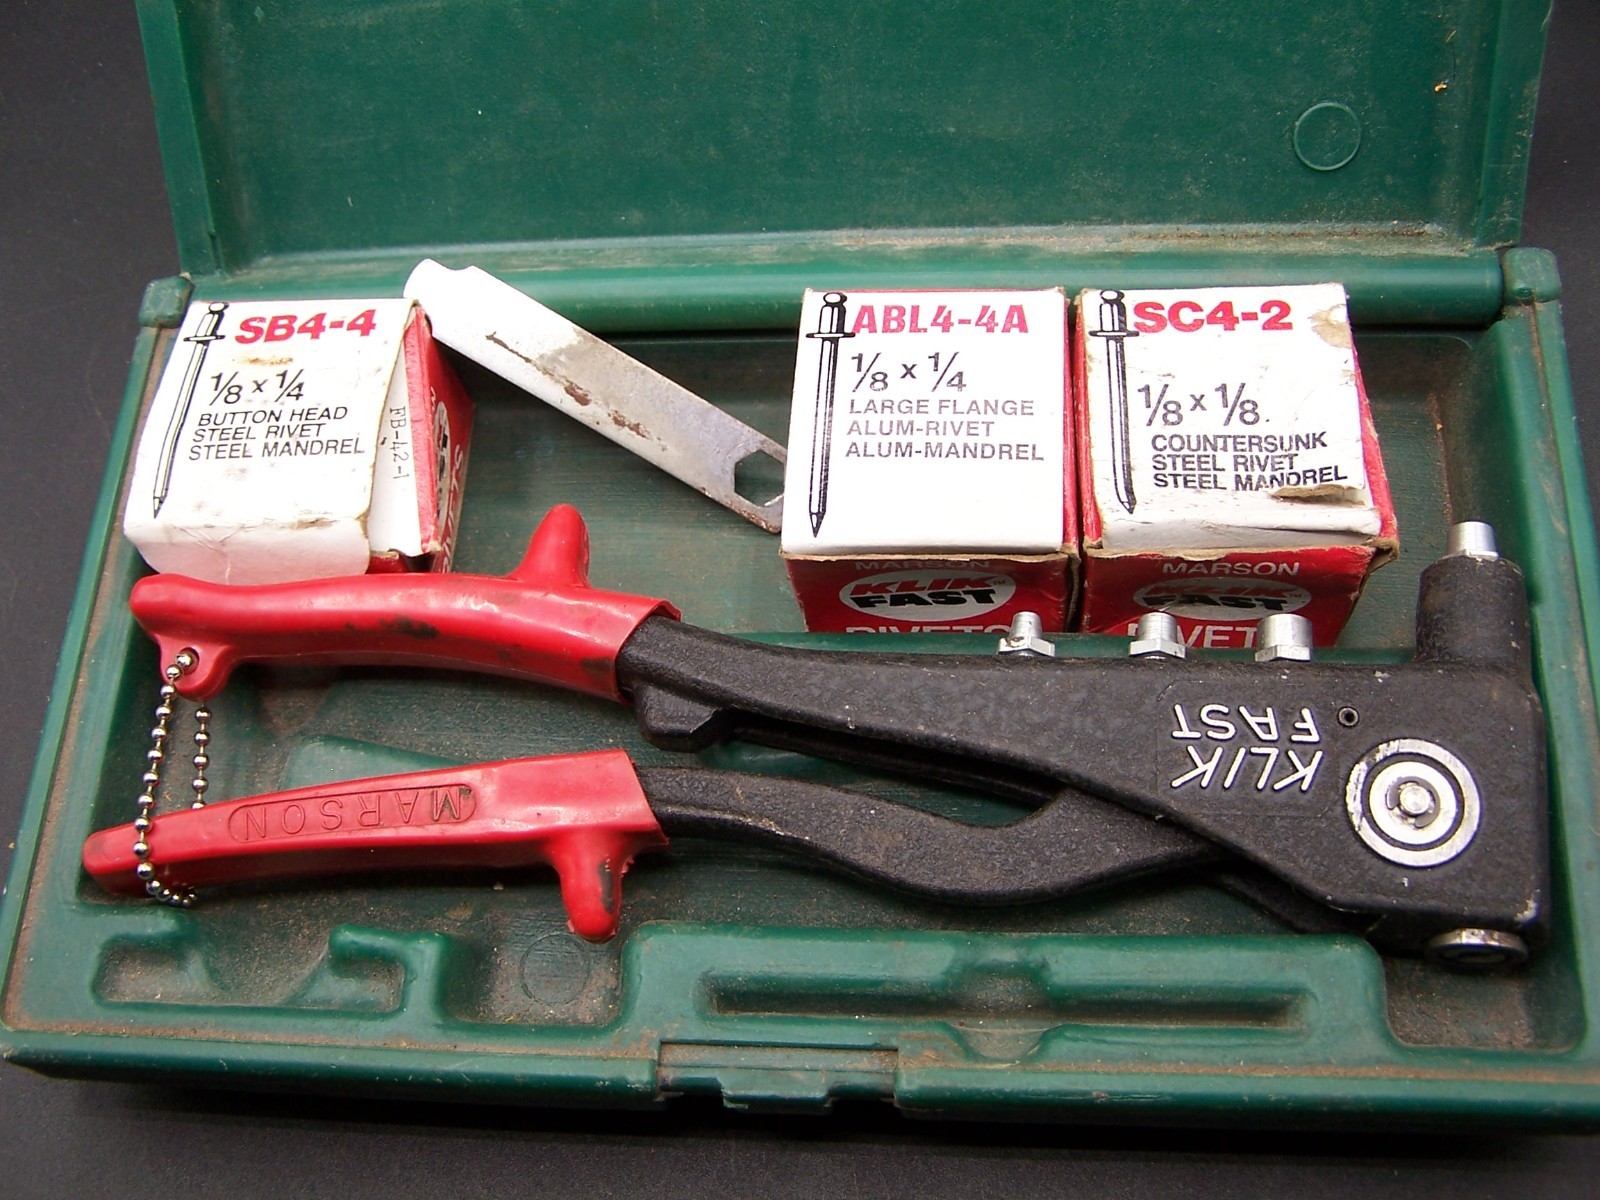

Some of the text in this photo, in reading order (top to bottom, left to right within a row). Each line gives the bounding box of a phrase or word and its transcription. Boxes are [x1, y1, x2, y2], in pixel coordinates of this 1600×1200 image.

[234, 309, 377, 345] SB4-4
[851, 304, 1030, 334] ABL4-4A
[1133, 299, 1294, 334] SC4-2
[851, 351, 967, 393] 1/8 x 1/4
[210, 369, 306, 406] 1/8 x 1/4
[197, 405, 349, 427] BUTTON HEAD
[849, 398, 1035, 417] LARGE FLANGE
[1136, 383, 1184, 427] 1/8
[1189, 393, 1208, 412] x
[192, 421, 327, 443] STEEL RIVET
[846, 419, 996, 438] ALUM-RIVET
[188, 436, 366, 462] STEEL MANDREL
[845, 441, 1046, 462] ALUM-MANDREL
[1150, 431, 1328, 453] COUNTERSUNK
[1151, 452, 1299, 473] STEEL RIVET
[1153, 464, 1349, 492] STEEL MANDREL
[1162, 561, 1300, 577] MARSON
[849, 575, 999, 597] KLIK
[850, 588, 997, 609] FAST
[1142, 593, 1289, 611] FAST
[1172, 703, 1321, 743] FAST
[1171, 745, 1323, 792] KLIK
[242, 785, 462, 841] MARSON
